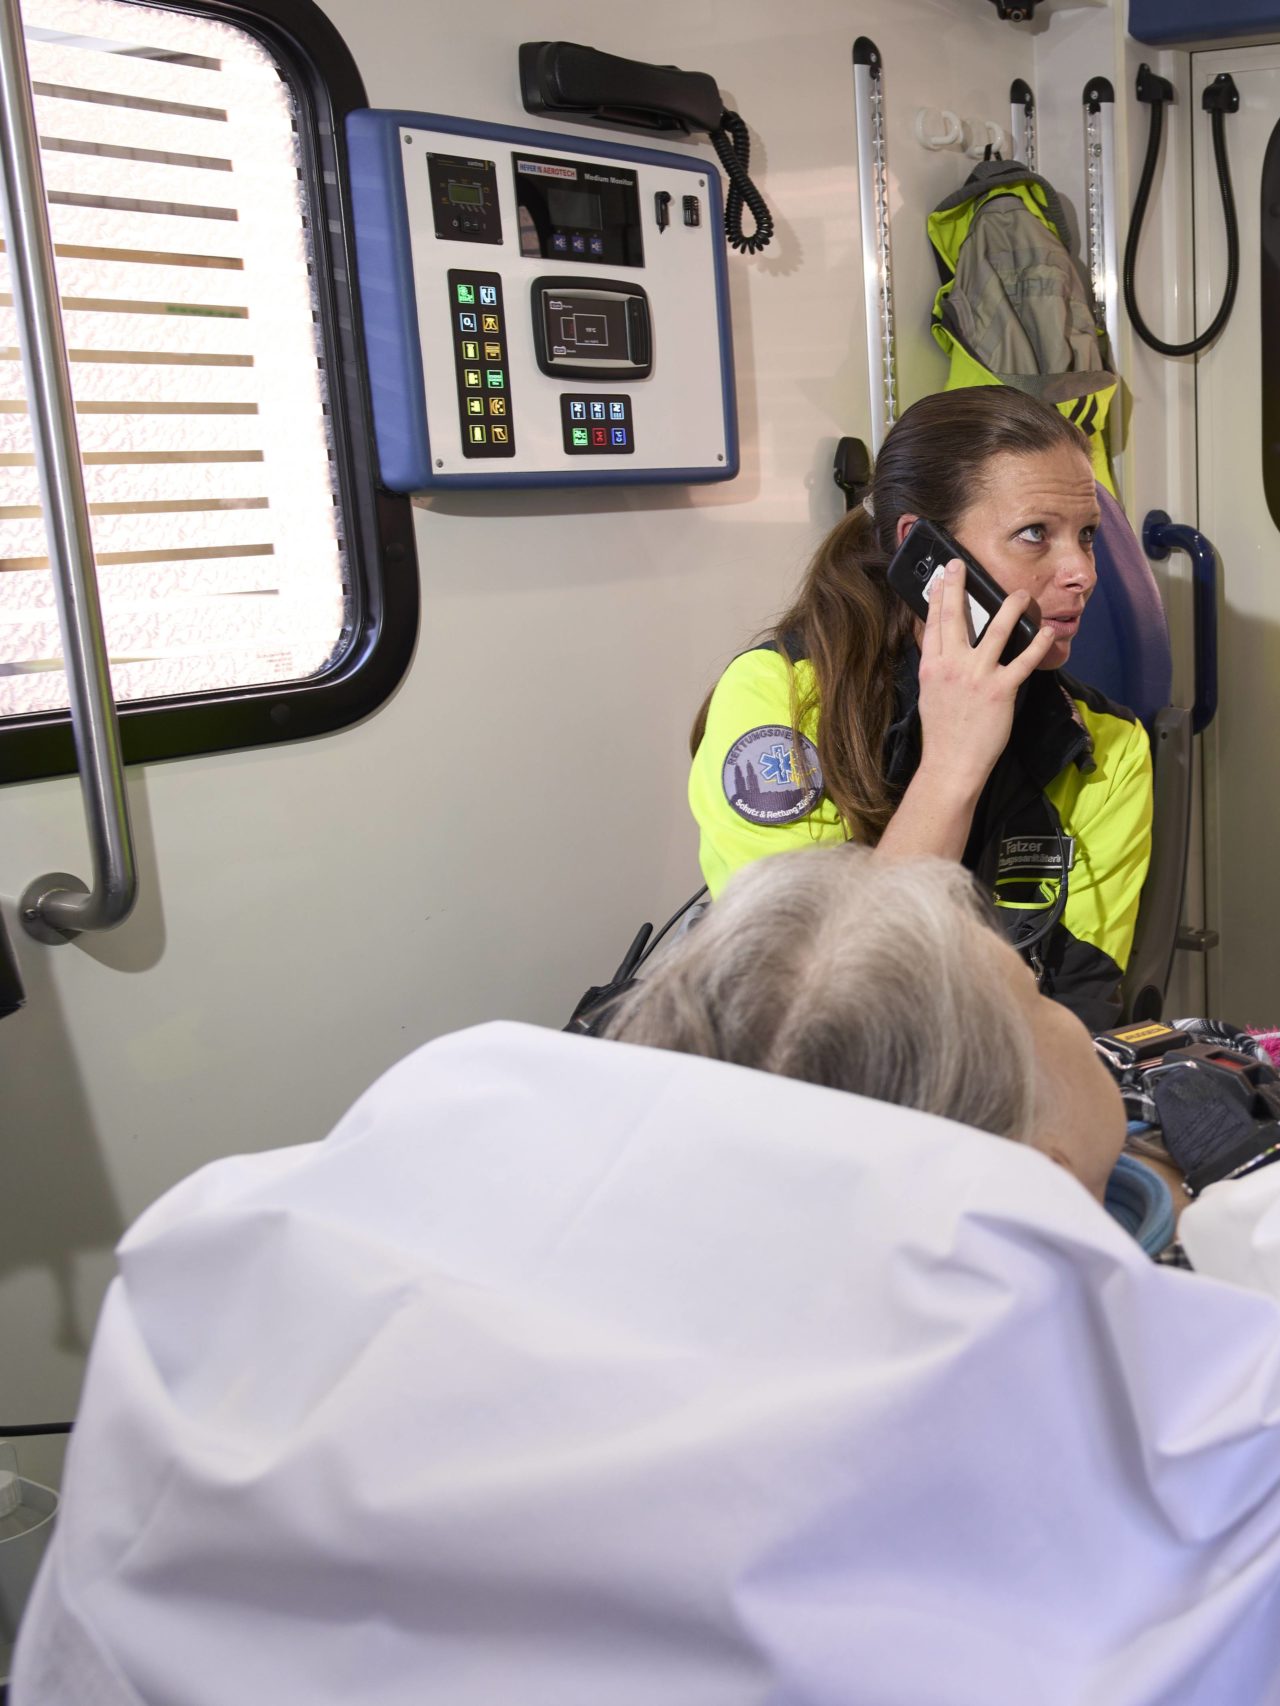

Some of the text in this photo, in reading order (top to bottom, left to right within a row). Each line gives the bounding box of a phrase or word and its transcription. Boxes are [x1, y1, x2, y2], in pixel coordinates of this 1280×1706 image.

[584, 173, 633, 186] Medium Monitor
[766, 805, 799, 819] Rettung
[1006, 840, 1042, 855] Fatzer
